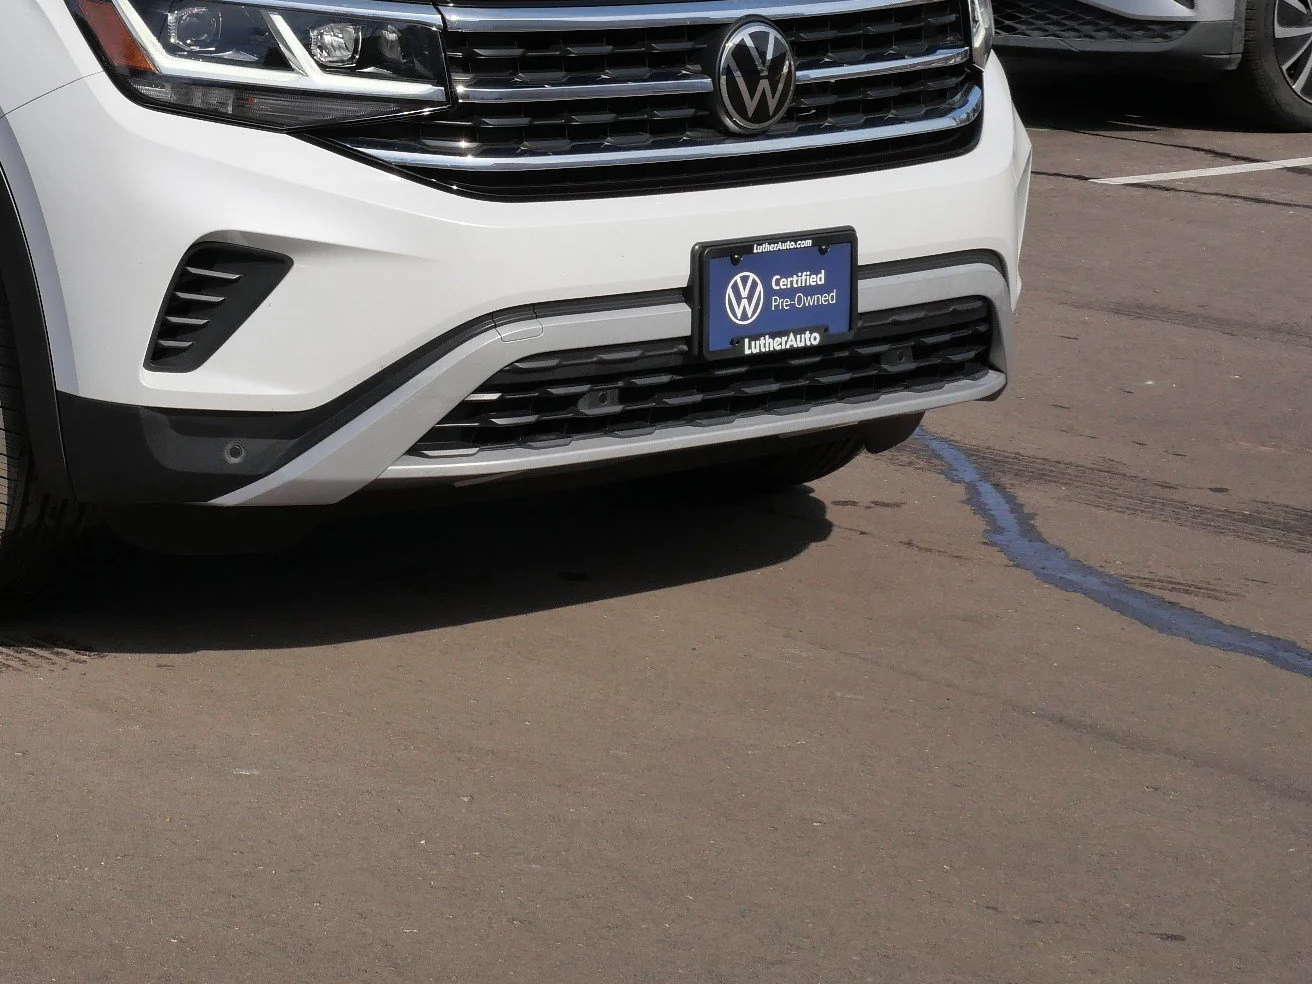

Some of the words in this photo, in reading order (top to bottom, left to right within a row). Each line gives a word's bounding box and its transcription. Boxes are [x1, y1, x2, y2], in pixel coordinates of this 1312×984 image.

[719, 22, 795, 130] VW
[753, 239, 812, 253] LutherAuto.com
[771, 270, 825, 290] Certified
[725, 271, 764, 325] VW
[771, 289, 836, 311] Pre-Owned
[744, 331, 821, 355] LutherAuto
